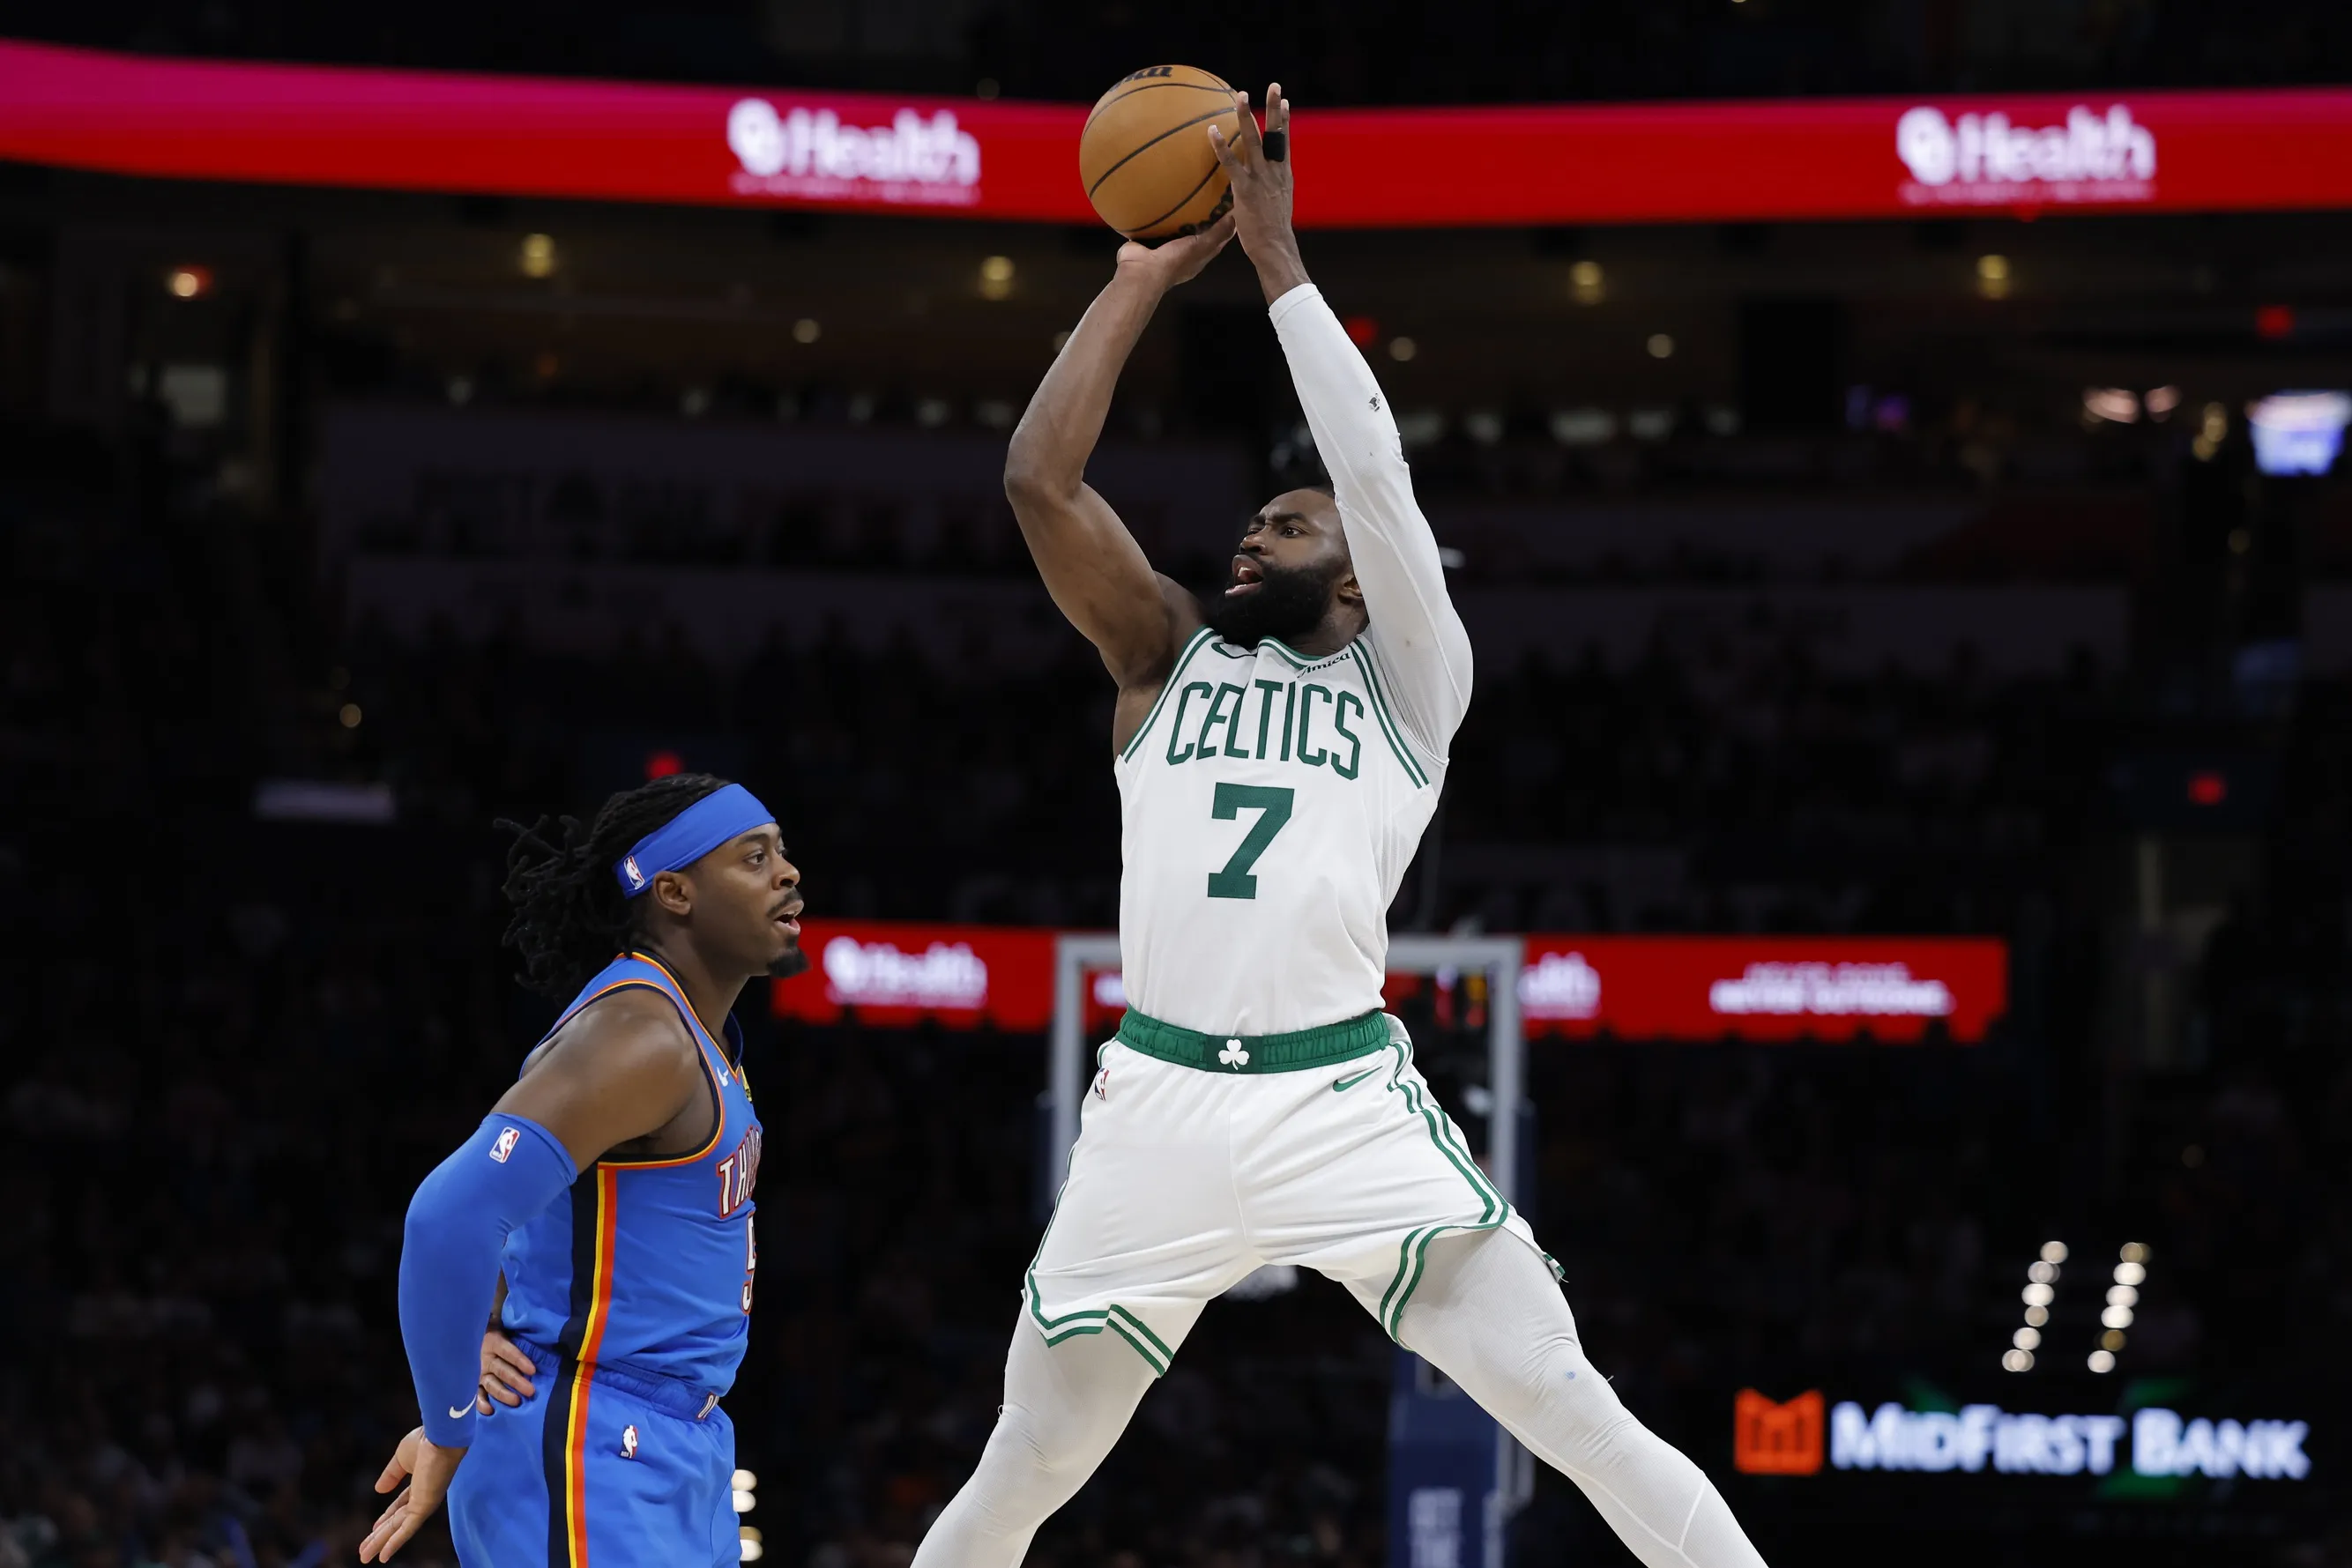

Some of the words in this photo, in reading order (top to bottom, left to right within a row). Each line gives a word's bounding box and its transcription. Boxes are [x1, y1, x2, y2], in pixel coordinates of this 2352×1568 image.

[1297, 653, 1351, 679] Amica
[1166, 679, 1365, 781] CELTICS
[1208, 782, 1295, 900] 7
